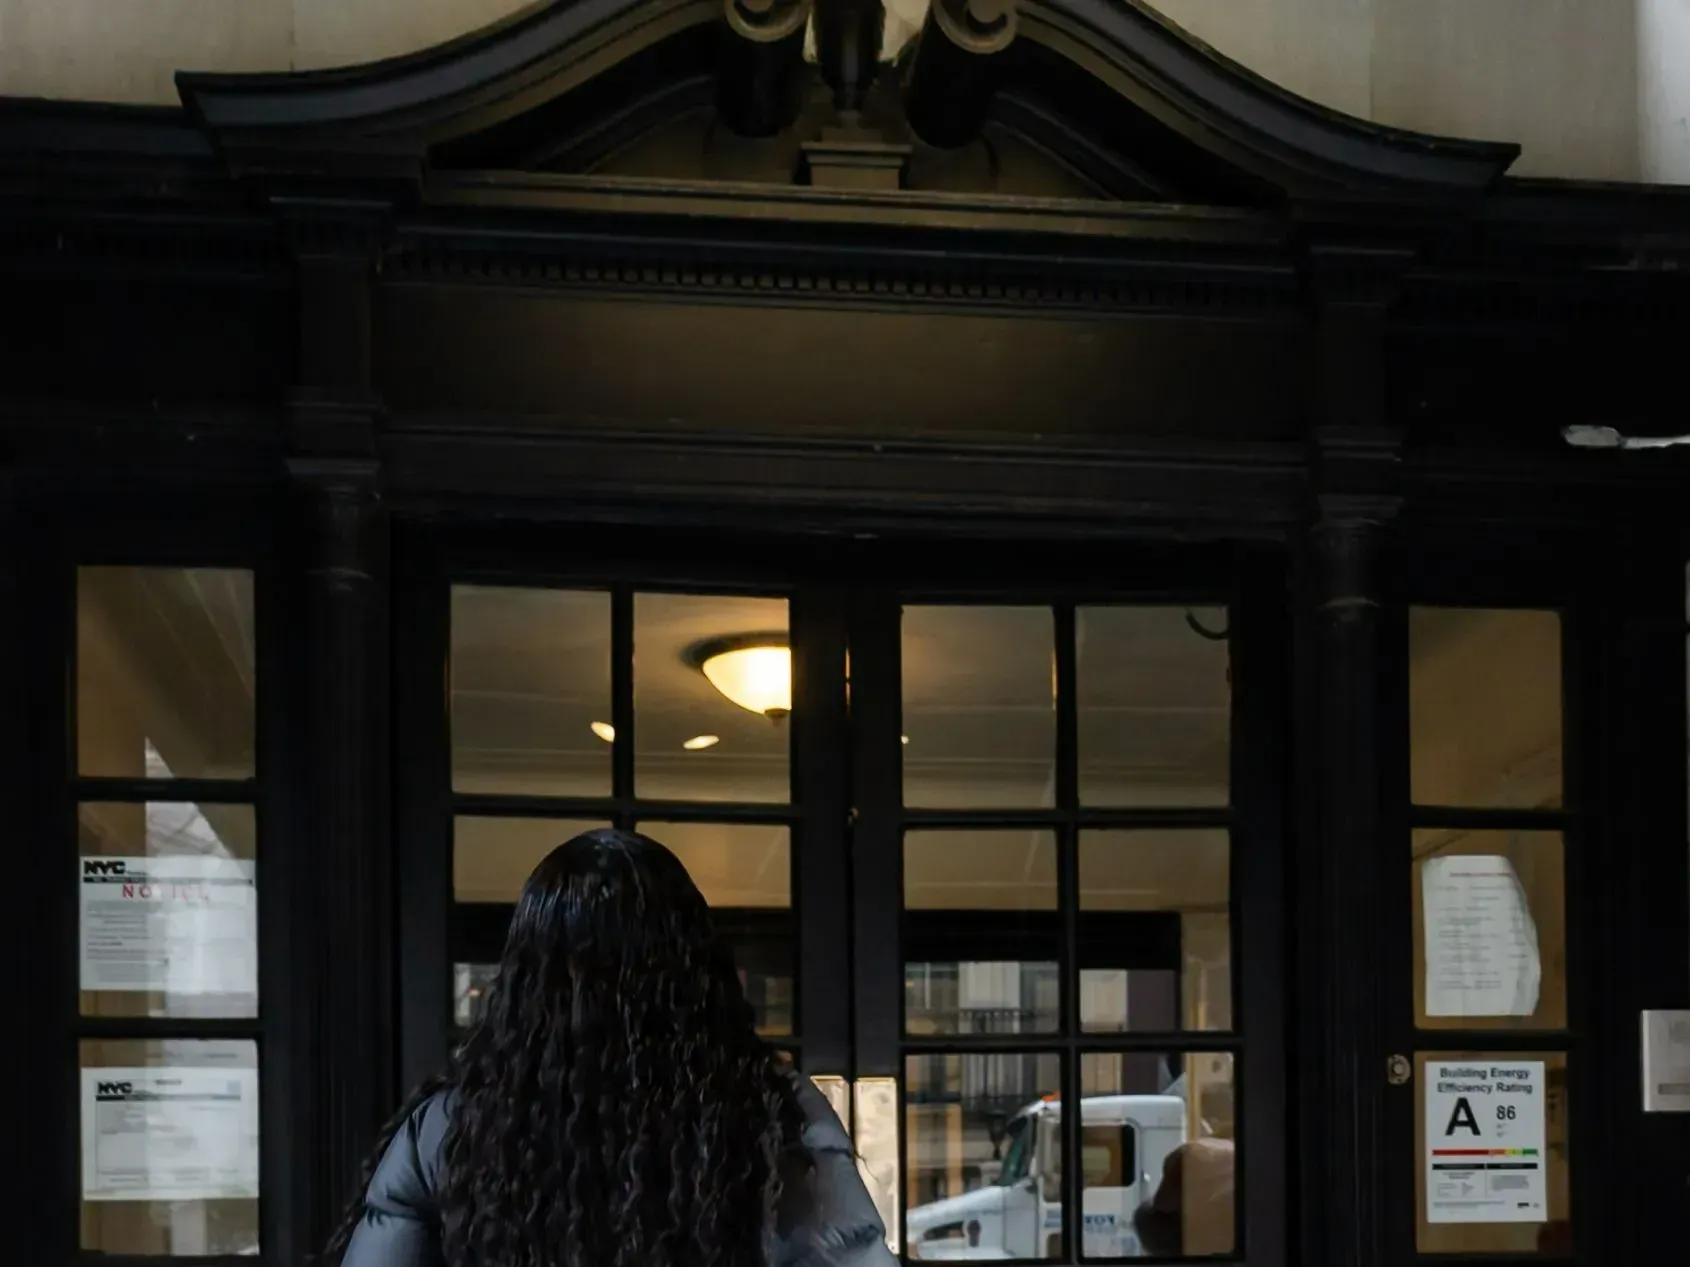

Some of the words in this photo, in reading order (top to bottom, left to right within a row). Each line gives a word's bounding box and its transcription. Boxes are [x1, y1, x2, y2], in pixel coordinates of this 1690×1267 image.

[84, 861, 126, 874] NYC
[123, 884, 209, 903] NOIC
[1440, 1067, 1487, 1080] Building
[1491, 1067, 1530, 1080] Energy
[98, 1082, 132, 1094] NYC
[1437, 1083, 1493, 1094] Efficiency
[1496, 1083, 1533, 1095] Rating
[1445, 1097, 1481, 1136] A
[1496, 1105, 1516, 1120] 86
